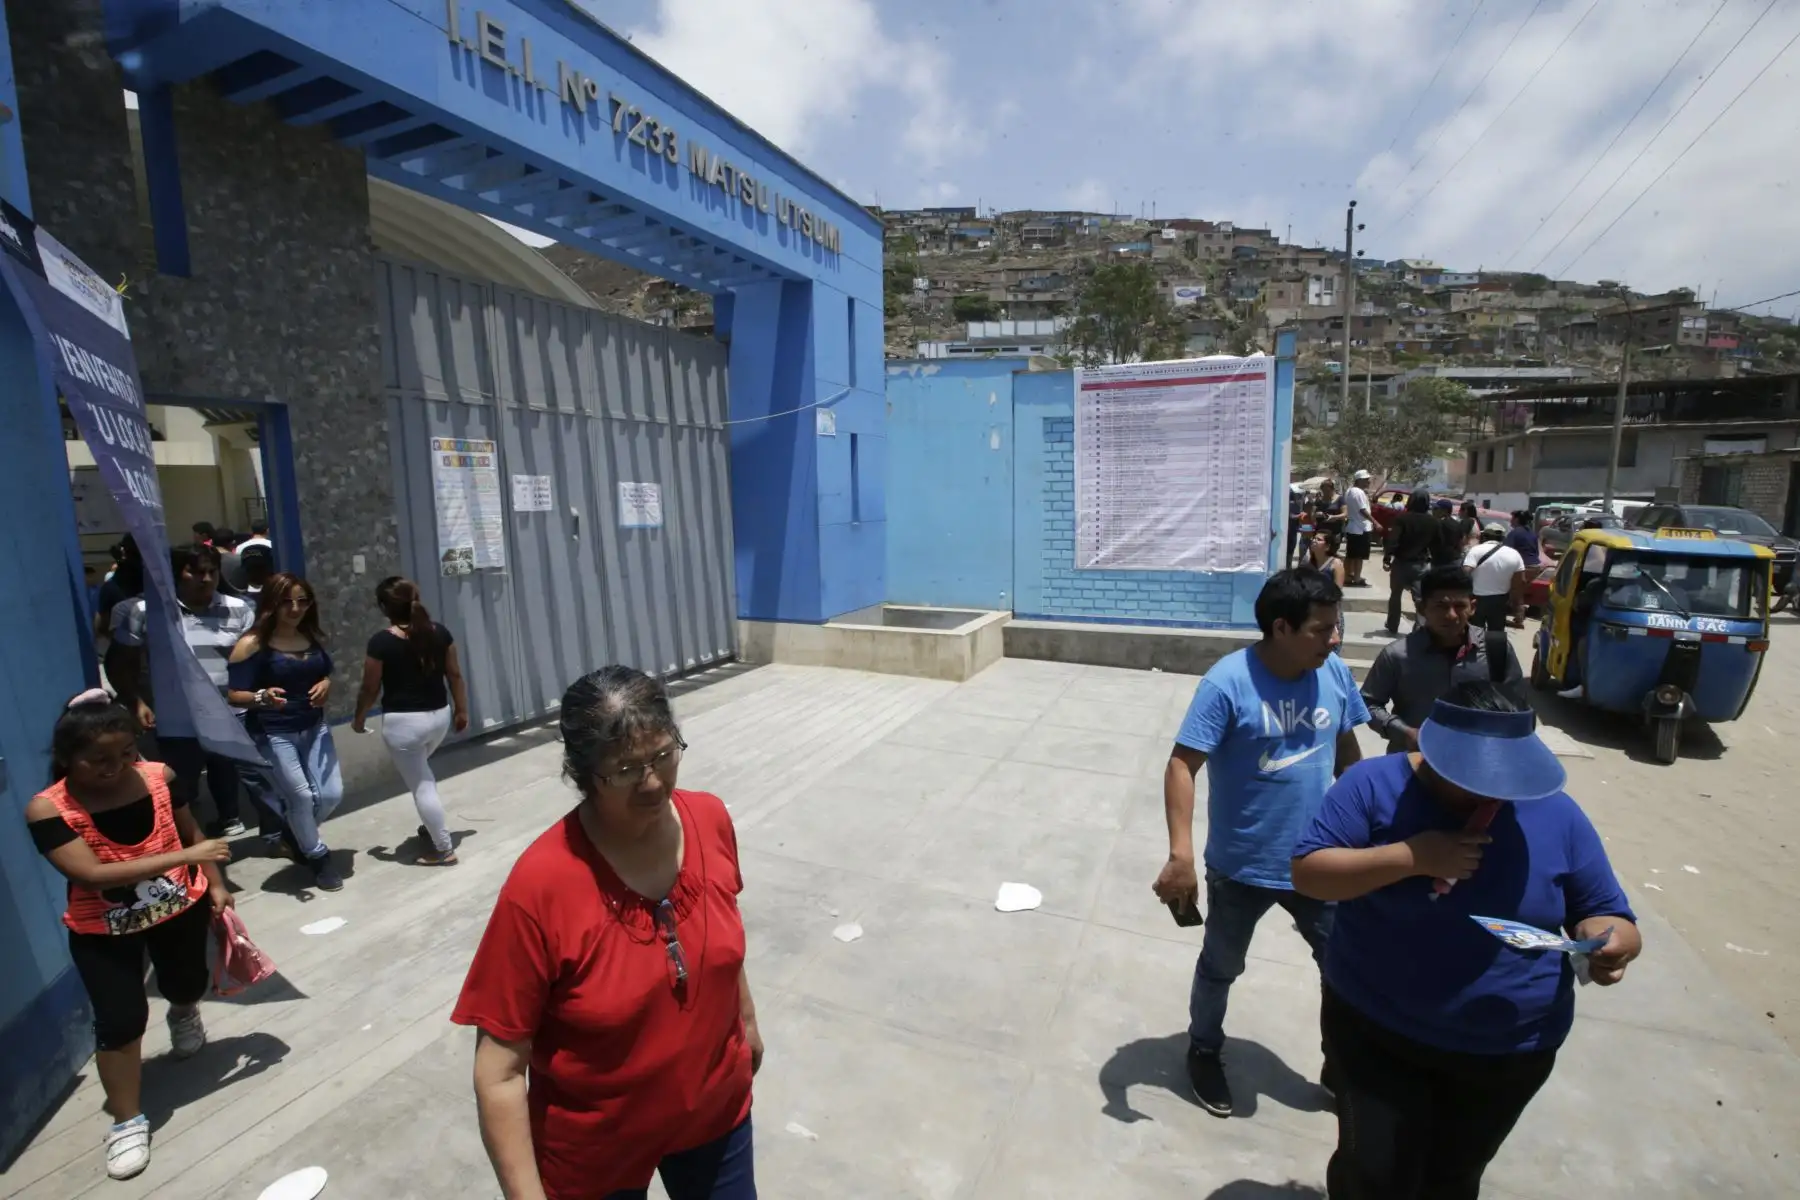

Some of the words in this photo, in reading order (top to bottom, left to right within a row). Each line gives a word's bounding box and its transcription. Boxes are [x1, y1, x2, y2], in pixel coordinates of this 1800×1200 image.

[608, 91, 680, 164] 7233
[687, 139, 769, 214] MATSU
[775, 192, 840, 255] UTSUMI
[50, 332, 140, 410] IENVENIDO
[1647, 615, 1692, 630] DANNY
[1260, 698, 1332, 736] Nike
